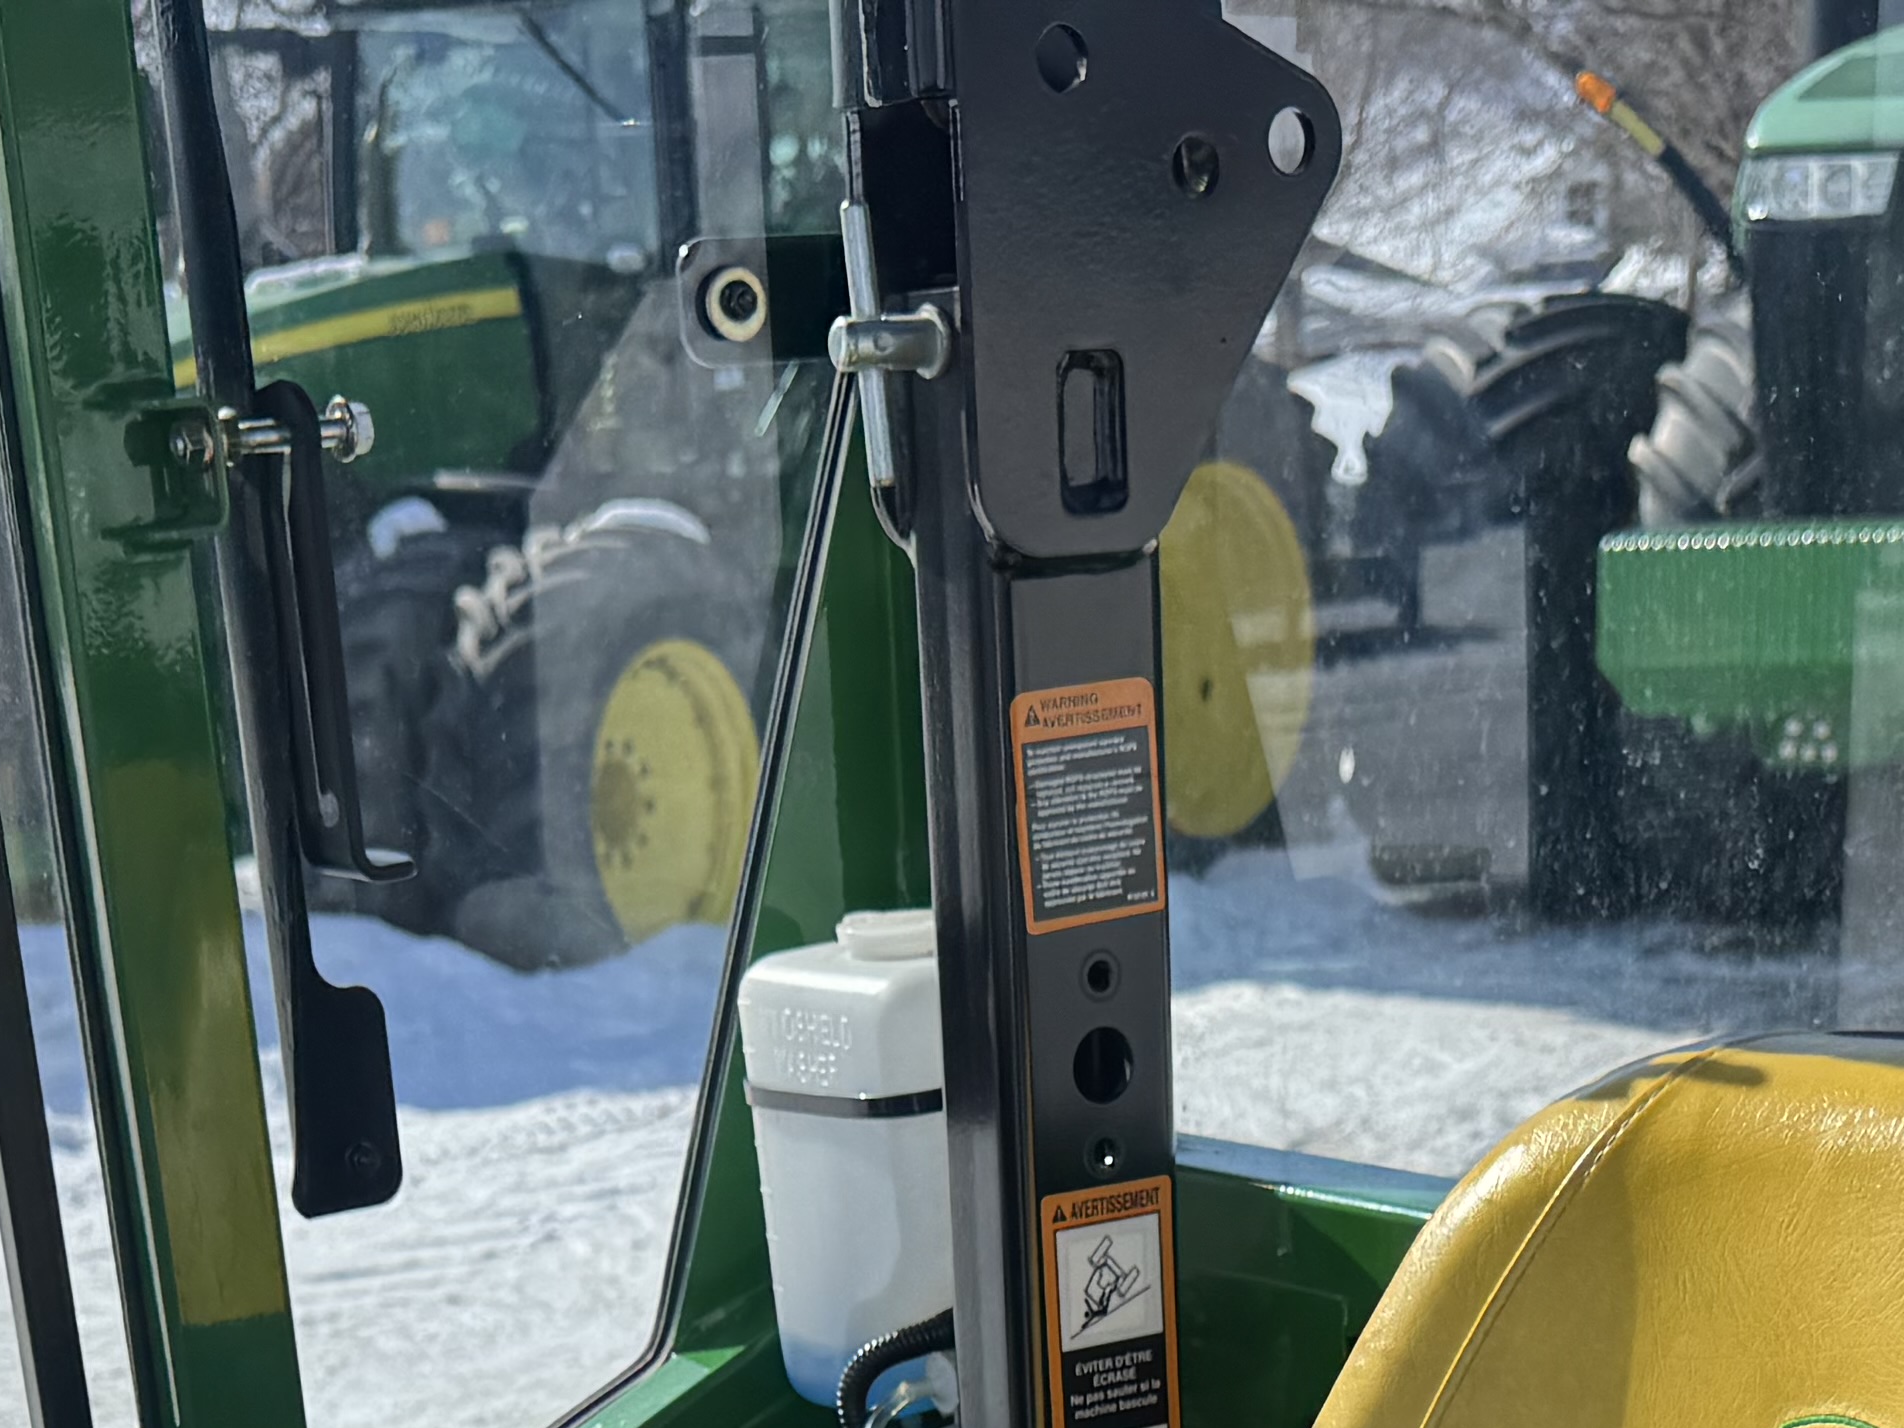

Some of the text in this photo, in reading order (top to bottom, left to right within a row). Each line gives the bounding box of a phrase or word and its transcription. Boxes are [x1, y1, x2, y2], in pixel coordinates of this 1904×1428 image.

[1039, 693, 1099, 713] WARNING
[1042, 703, 1142, 728] AVERTISSEMENT
[1070, 1186, 1161, 1220] AVERTISSEMENT
[1075, 1349, 1153, 1377] ÉVITER D'ÊTRE
[1093, 1366, 1137, 1388] ÉCRASÉ
[1070, 1393, 1085, 1407] Ne
[1086, 1390, 1105, 1407] pas
[1107, 1383, 1138, 1400] sauter
[1074, 1394, 1158, 1420] machine bascule
